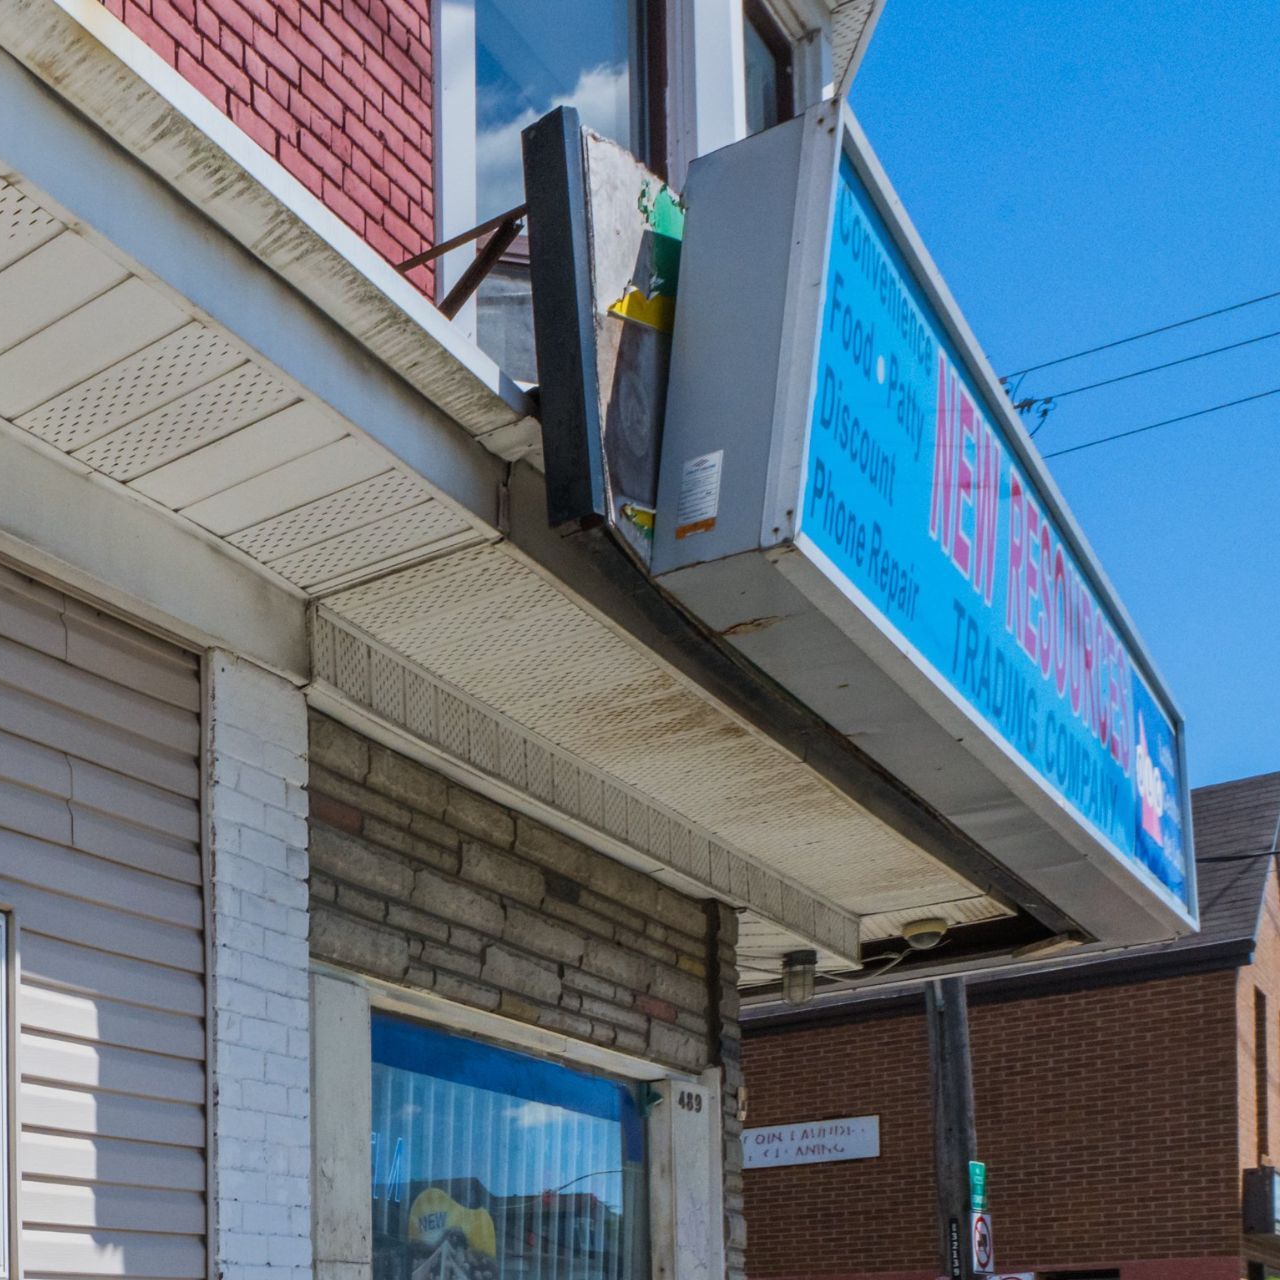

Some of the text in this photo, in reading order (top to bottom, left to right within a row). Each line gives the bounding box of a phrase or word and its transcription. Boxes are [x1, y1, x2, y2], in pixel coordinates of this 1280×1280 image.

[830, 271, 926, 463] Food Patty
[840, 184, 933, 378] Convenience
[820, 362, 897, 508] Discount
[810, 456, 920, 622] Phone Repair
[929, 347, 1133, 779] NEW RESOURCES
[952, 597, 1119, 836] TRADING COMPANY
[678, 1091, 703, 1114] 489
[418, 1211, 448, 1234] NEW
